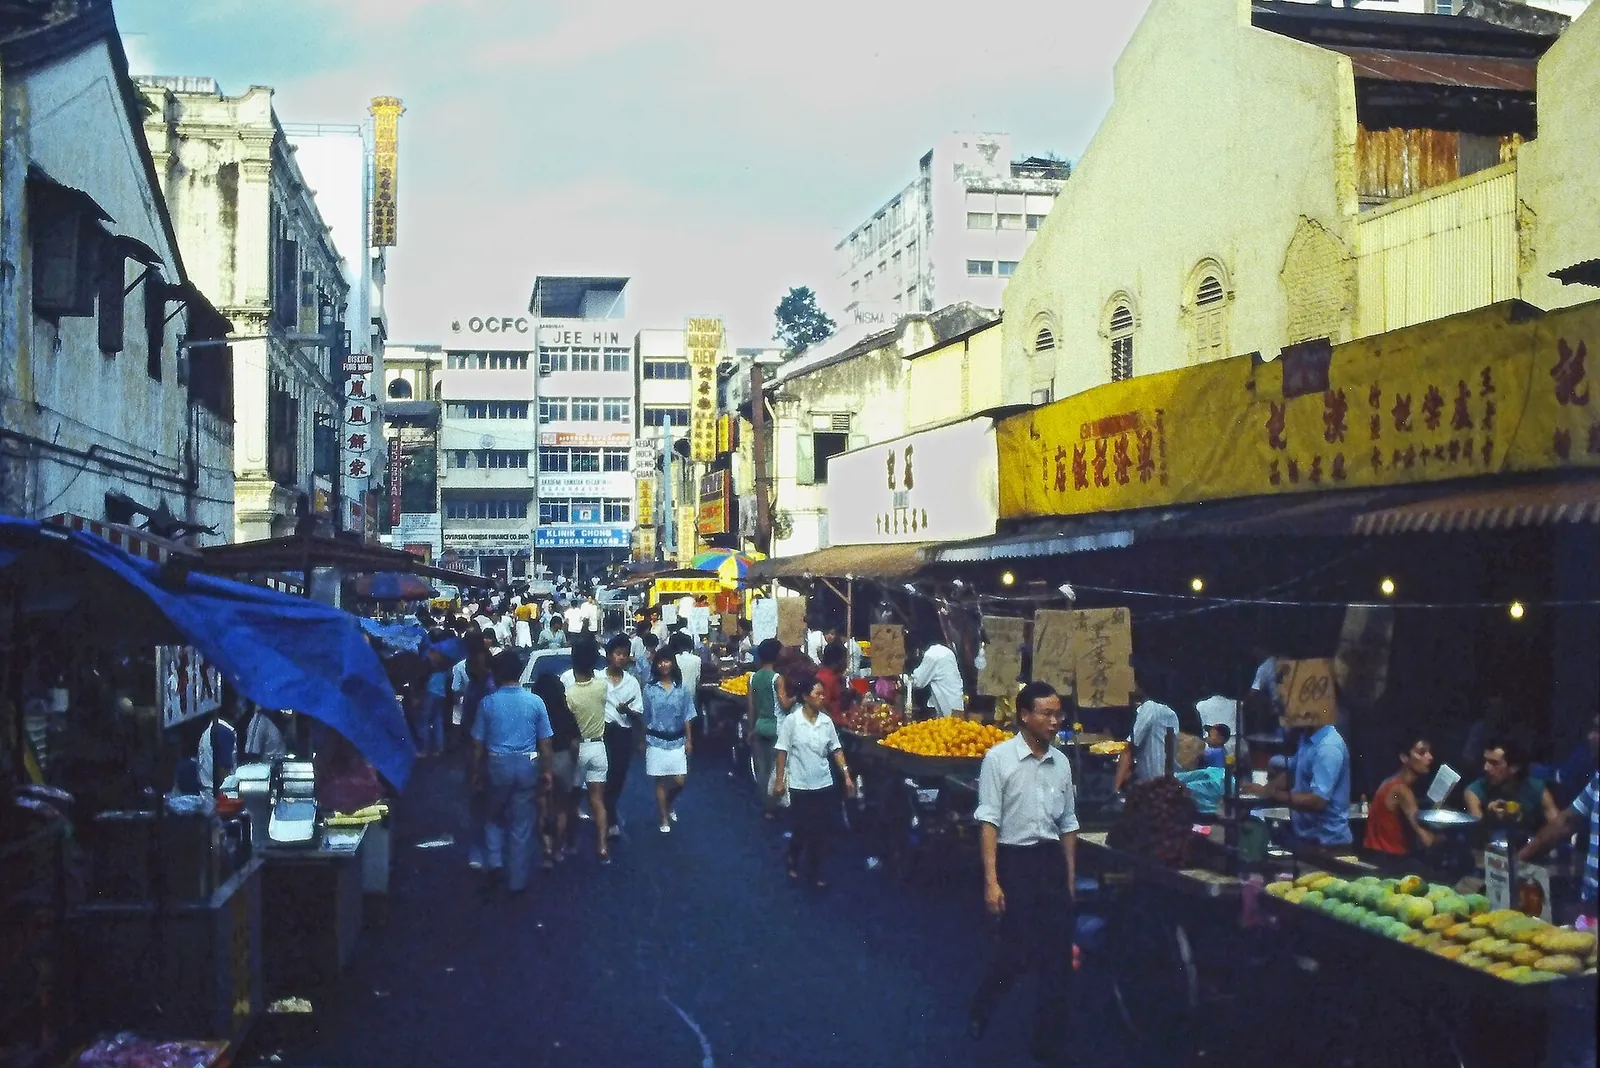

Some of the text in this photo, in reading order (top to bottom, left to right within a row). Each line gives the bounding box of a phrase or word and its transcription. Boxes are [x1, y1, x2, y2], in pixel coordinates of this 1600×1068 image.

[854, 309, 885, 324] WISMA
[468, 316, 529, 333] OCFC
[553, 331, 619, 344] JEE HIN
[546, 529, 576, 537] KLINIK
